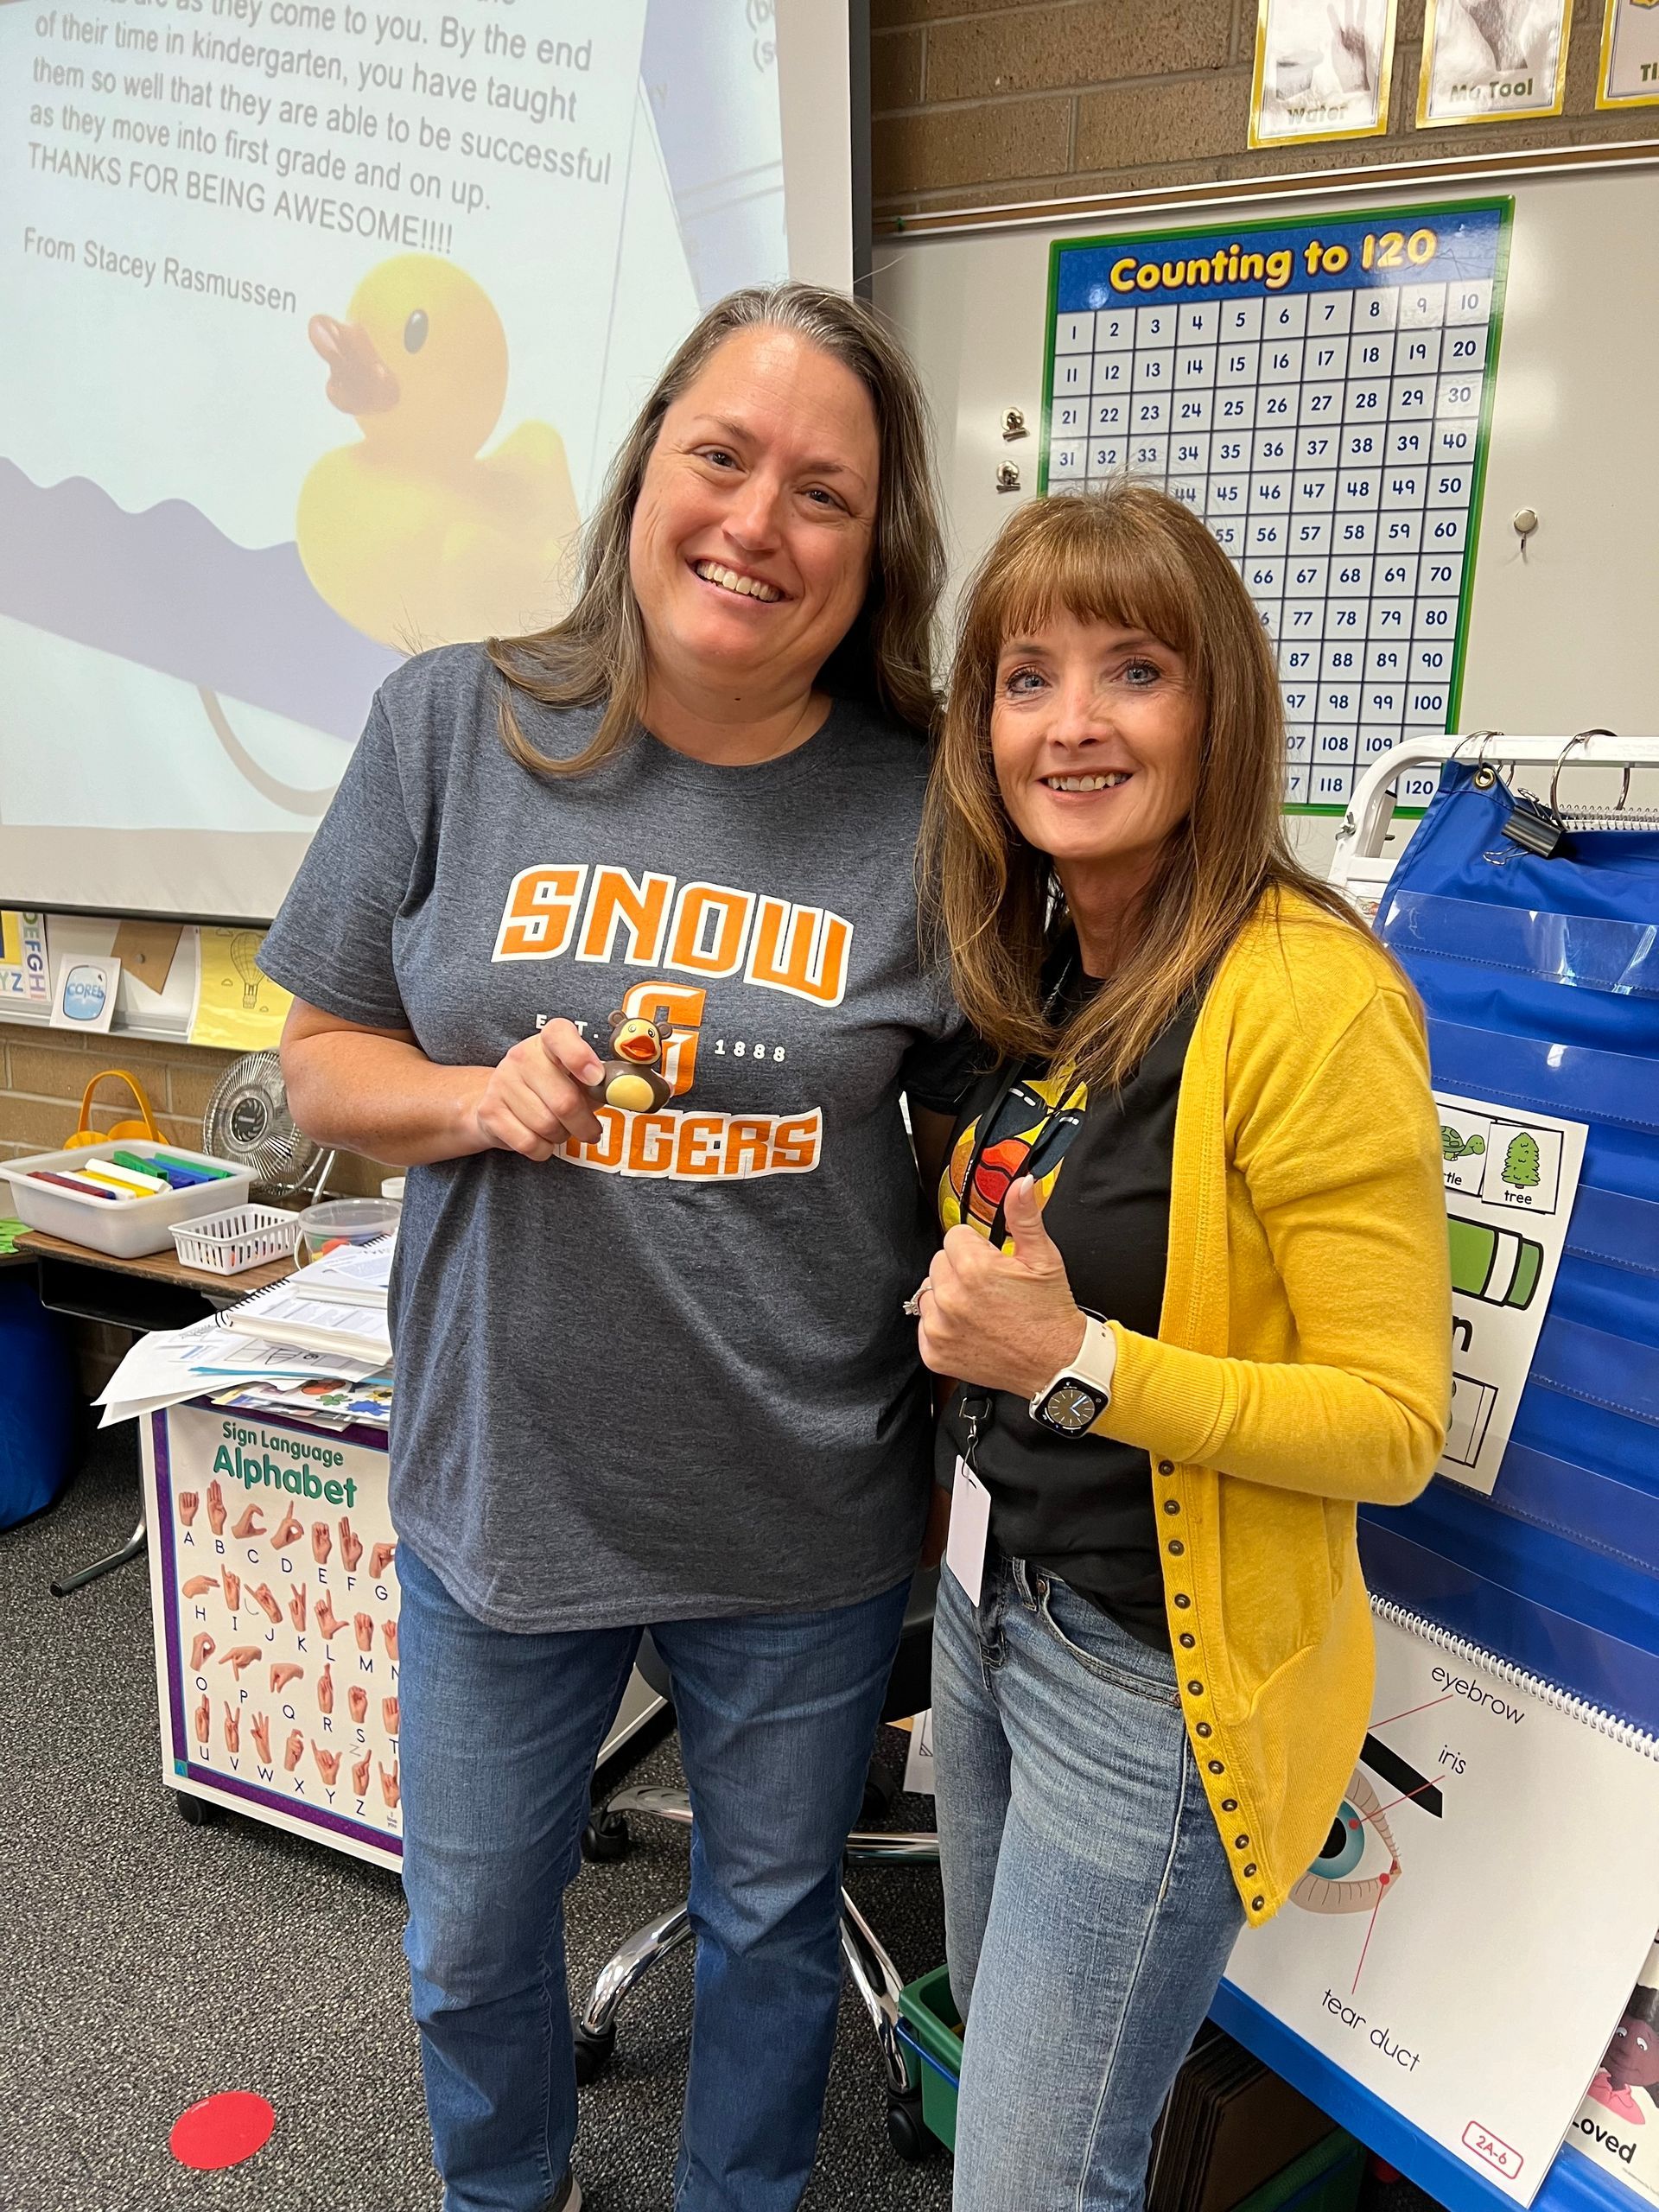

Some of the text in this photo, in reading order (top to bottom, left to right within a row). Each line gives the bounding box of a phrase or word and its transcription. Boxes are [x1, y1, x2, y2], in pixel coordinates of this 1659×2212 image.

[270, 2, 336, 32] come
[344, 4, 367, 35] to
[374, 14, 428, 46] you.
[440, 15, 476, 60] By
[484, 23, 527, 60] the
[537, 38, 593, 72] end
[35, 10, 577, 124] of their time in kindergarten, you have taught
[1489, 78, 1534, 99] Tool
[33, 56, 612, 186] them so well that they are able to be successful
[29, 104, 491, 215] as they move into first grade and on up.
[28, 141, 453, 255] THANKS FOR BEING AWESOME!!!!
[24, 226, 296, 314] From Stacey Rasmussen
[1109, 227, 1439, 292] Counting to 120
[1071, 301, 1381, 340] 1 2 3 4 5 6 7 8
[1066, 340, 1477, 383] 11 12 13 14 15 16 17 18 20
[1061, 389, 1424, 425] 21 22 23 24 25 26 27 28 29
[1178, 435, 1420, 461] 34 35 36 37 38 39
[1217, 477, 1462, 501] 45 46 47 48 49 50
[1255, 522, 1458, 543] 56 57 59 60
[1296, 566, 1452, 584] 67 68 69 70
[1293, 610, 1448, 626] 77 78 79 80
[1289, 652, 1443, 668] 87 88 89 90
[1286, 694, 1443, 710] 97 98 99 100
[1322, 736, 1349, 752] 108
[1320, 777, 1433, 795] 118 120
[492, 864, 855, 1007] SNOW
[535, 1013, 786, 1063] ET. 1888
[553, 1103, 823, 1182] DGERS
[1444, 1172, 1463, 1185] tle
[1504, 1190, 1533, 1205] tree
[222, 1421, 344, 1467] Sign Language
[213, 1445, 358, 1508] Alphabet
[183, 1530, 389, 1601] A B C D E F G
[195, 1605, 373, 1674] H I J K L M
[195, 1676, 365, 1744] O P Q R S
[1431, 1664, 1526, 1726] eyebrow
[199, 1745, 366, 1817] U V W X Y Z
[1438, 1743, 1466, 1775] iris
[1321, 1988, 1421, 2072] tear duct
[1475, 2135, 1507, 2165] 2A-6
